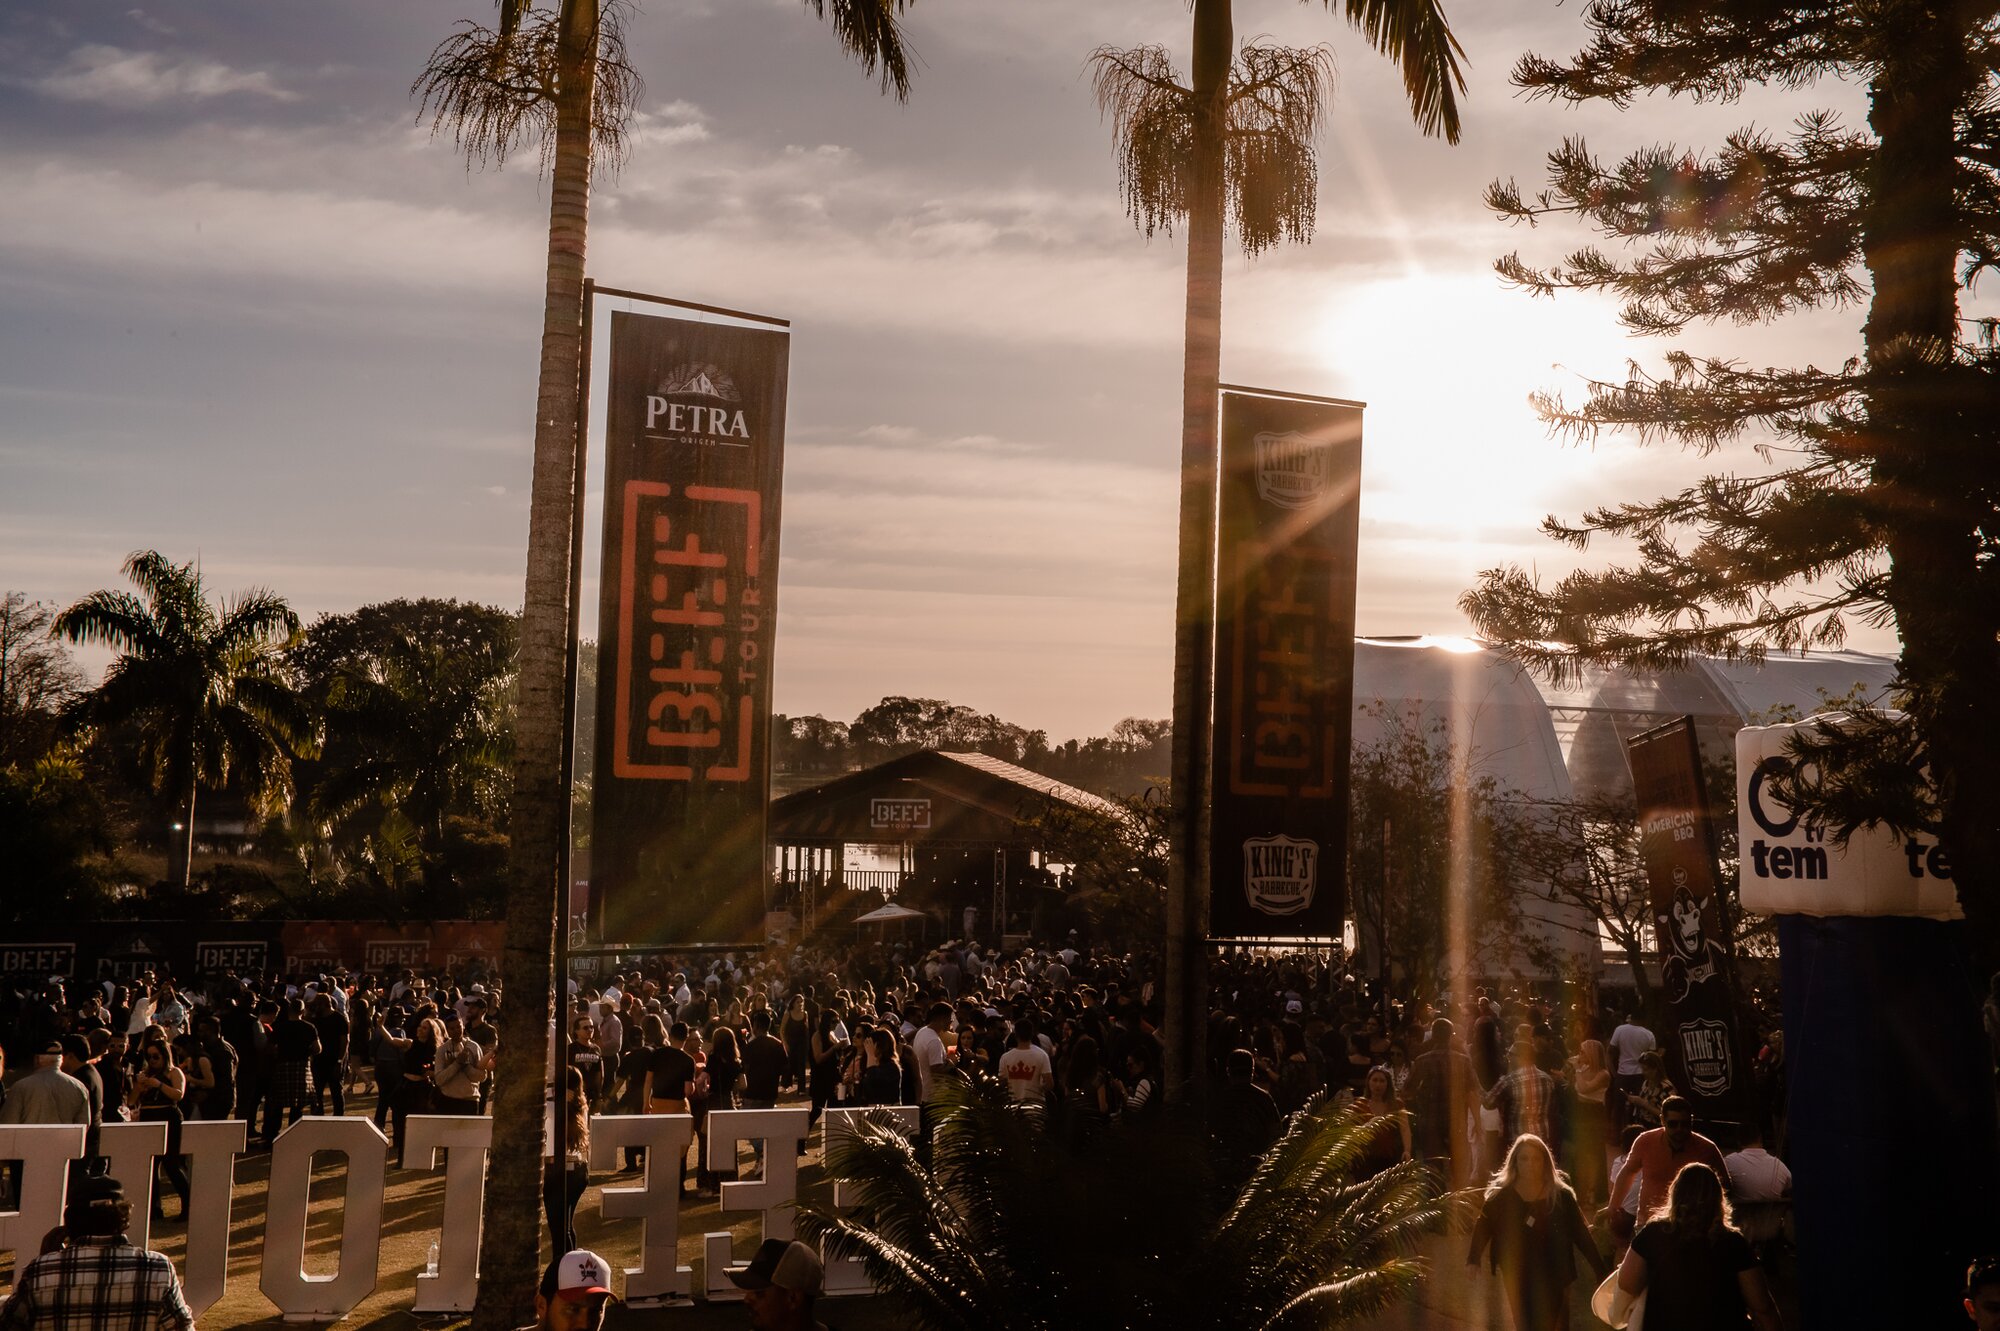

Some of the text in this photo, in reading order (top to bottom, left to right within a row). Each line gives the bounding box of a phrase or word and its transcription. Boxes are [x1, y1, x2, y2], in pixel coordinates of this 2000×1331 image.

[645, 395, 750, 438] PETRA
[680, 436, 716, 446] ORIGEM
[1261, 440, 1326, 476] KING'S
[647, 513, 728, 749] BEEF
[738, 586, 762, 683] TOUR
[1255, 570, 1317, 769] BEEF
[877, 804, 925, 822] BEEF
[1647, 811, 1695, 835] AMERICAN
[1673, 826, 1695, 842] BBQ
[1805, 826, 1825, 842] tv
[1251, 846, 1312, 879] KING'S
[1751, 838, 1952, 879] tem te
[1260, 880, 1301, 896] BARBECUE
[3, 951, 67, 971] BEEF
[203, 948, 260, 967] BEEF
[372, 946, 423, 966] BEEF
[1683, 1029, 1725, 1061] KING'S
